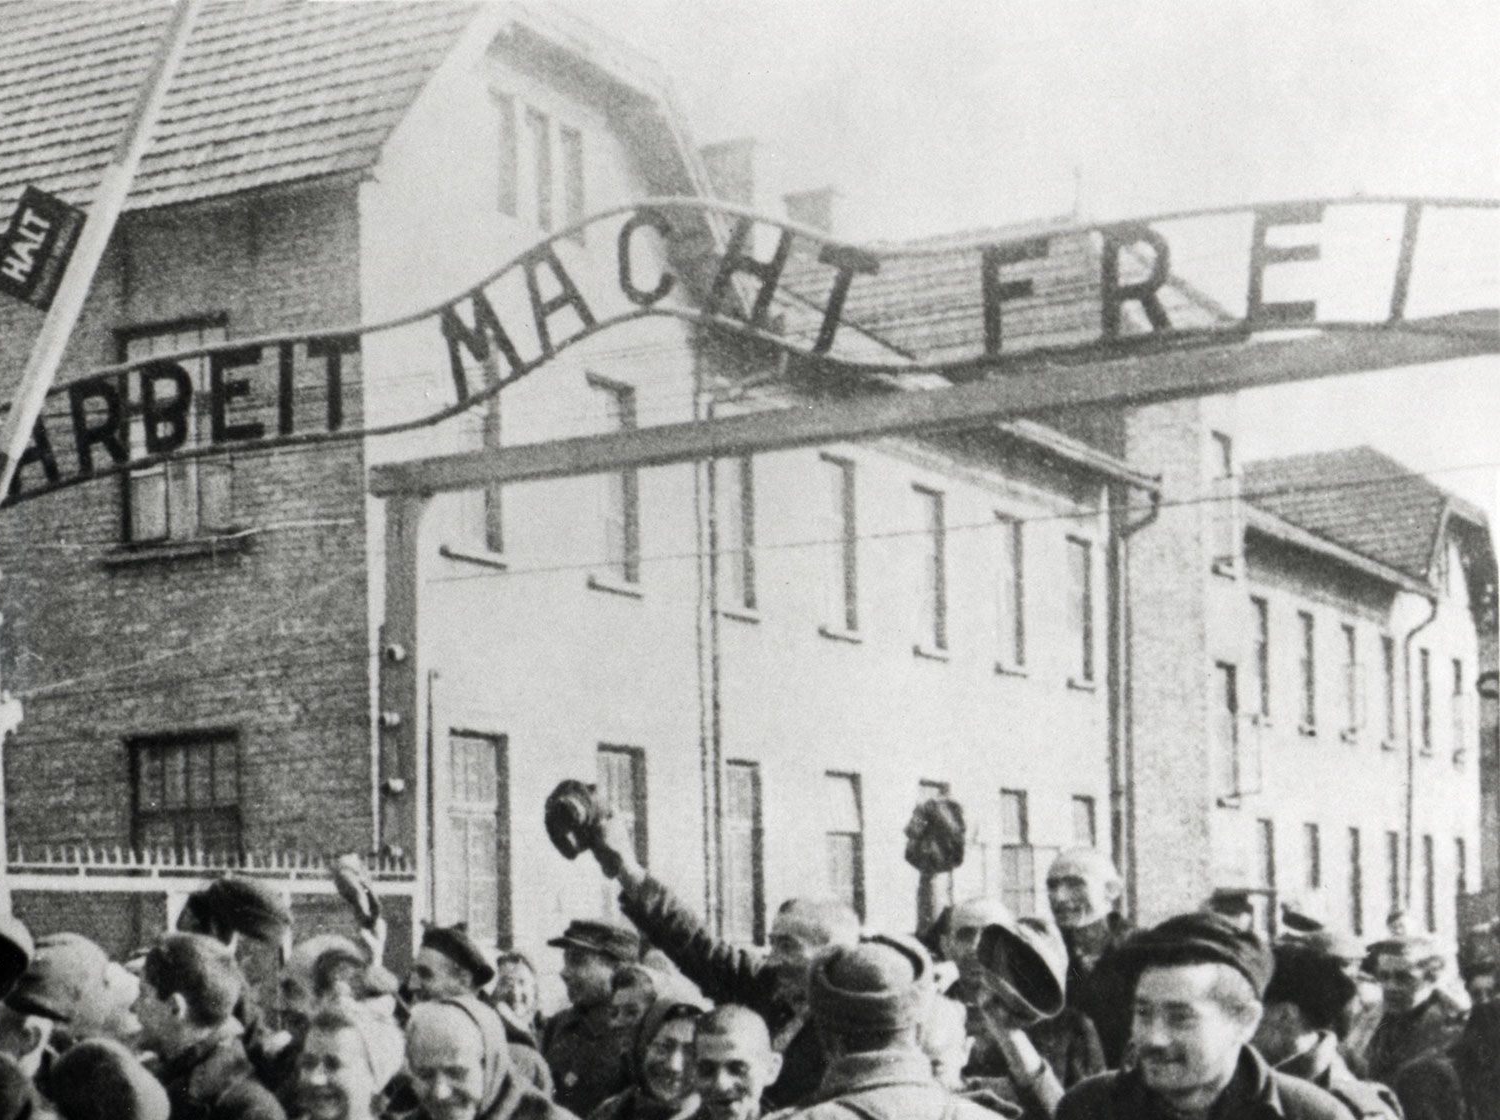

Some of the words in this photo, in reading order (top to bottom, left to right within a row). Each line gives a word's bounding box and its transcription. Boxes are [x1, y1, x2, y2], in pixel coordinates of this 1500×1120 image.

[1, 207, 50, 282] HALT
[440, 205, 880, 402] MACHT
[981, 201, 1423, 358] FREI
